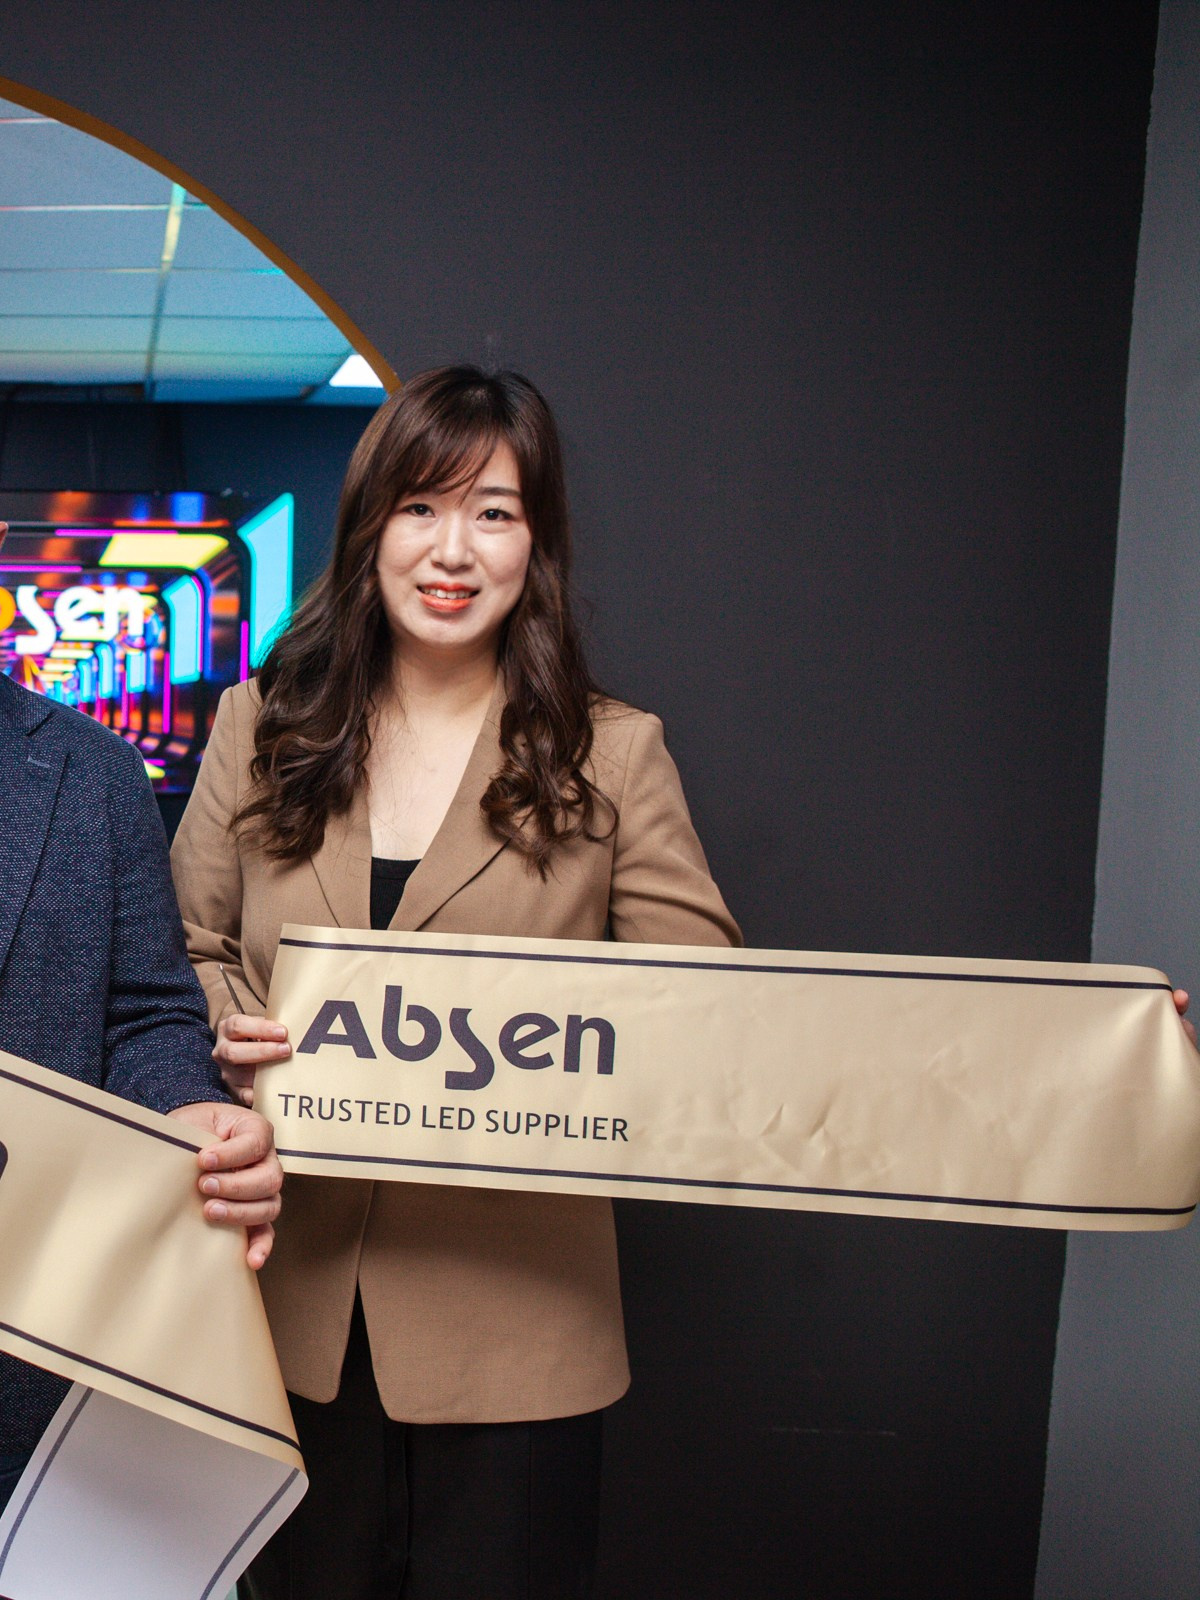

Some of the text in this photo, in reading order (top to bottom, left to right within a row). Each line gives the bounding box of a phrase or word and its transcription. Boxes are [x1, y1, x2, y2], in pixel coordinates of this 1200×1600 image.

[295, 984, 616, 1091] Absen
[277, 1093, 629, 1142] TRUSTED LED SUPPLIER
